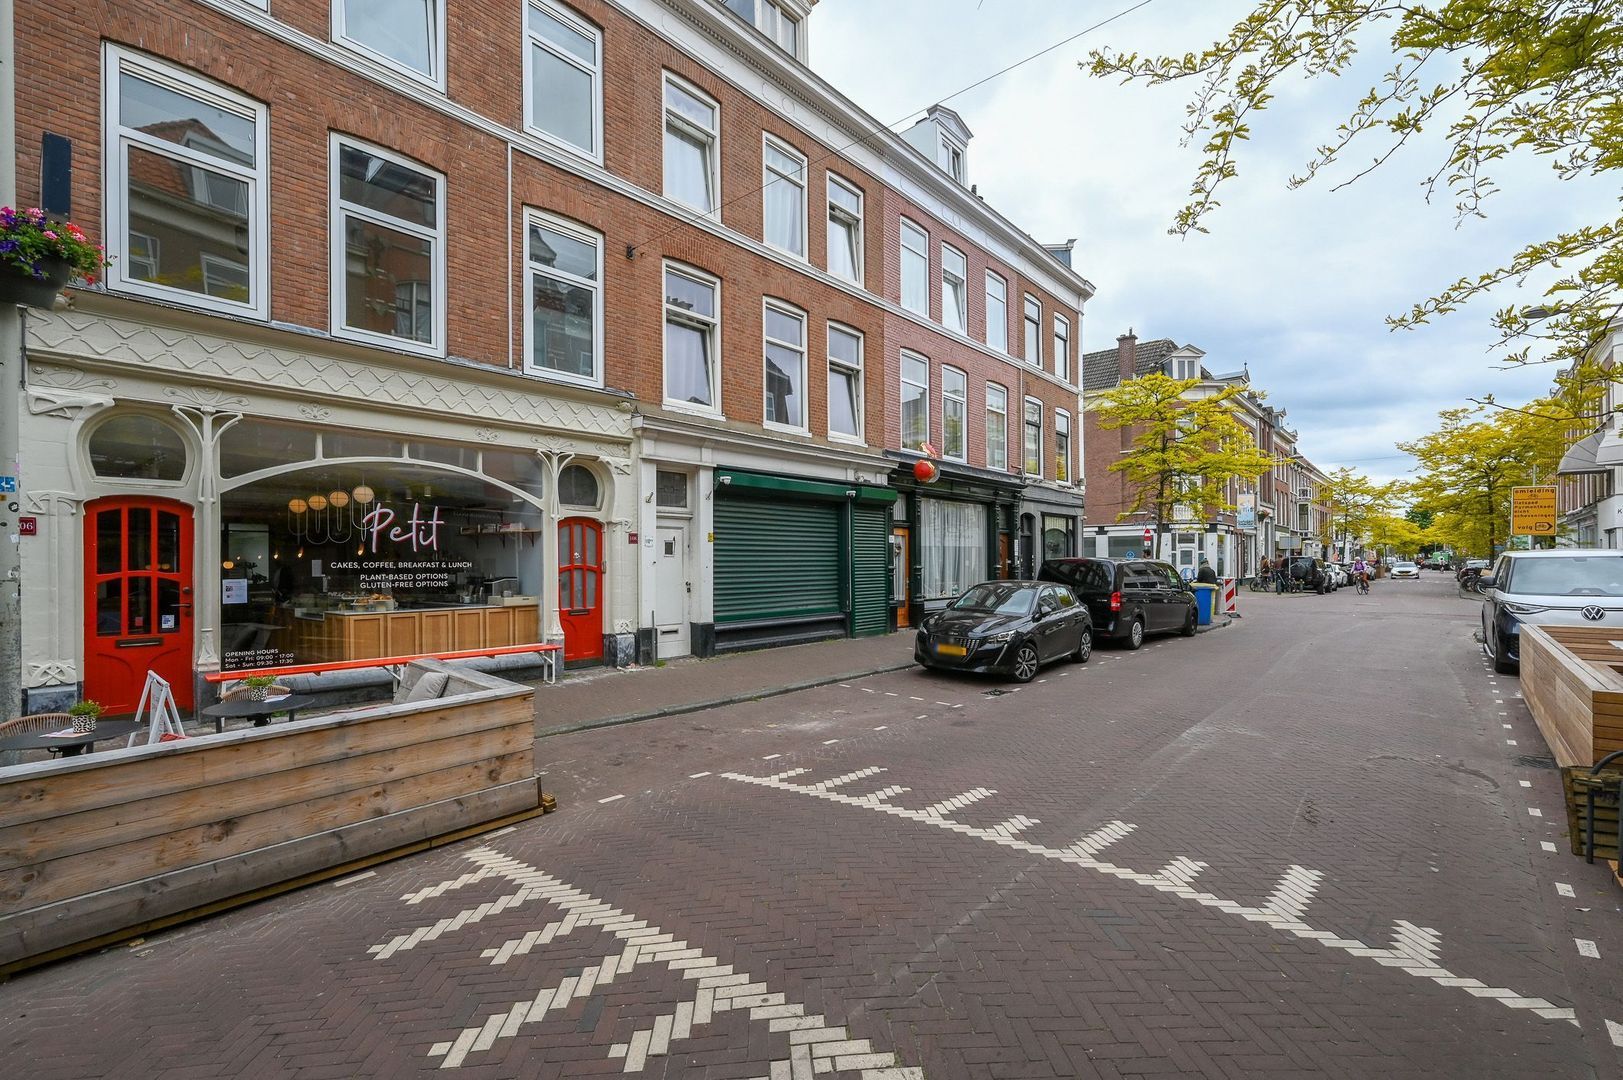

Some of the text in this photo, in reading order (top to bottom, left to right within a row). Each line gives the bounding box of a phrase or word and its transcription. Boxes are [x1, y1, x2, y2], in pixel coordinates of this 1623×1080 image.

[362, 502, 446, 553] Petit
[398, 561, 439, 569] BREAKFAST
[360, 573, 413, 581] PLANT-BASED
[360, 581, 414, 589] GLUTEN-FREE
